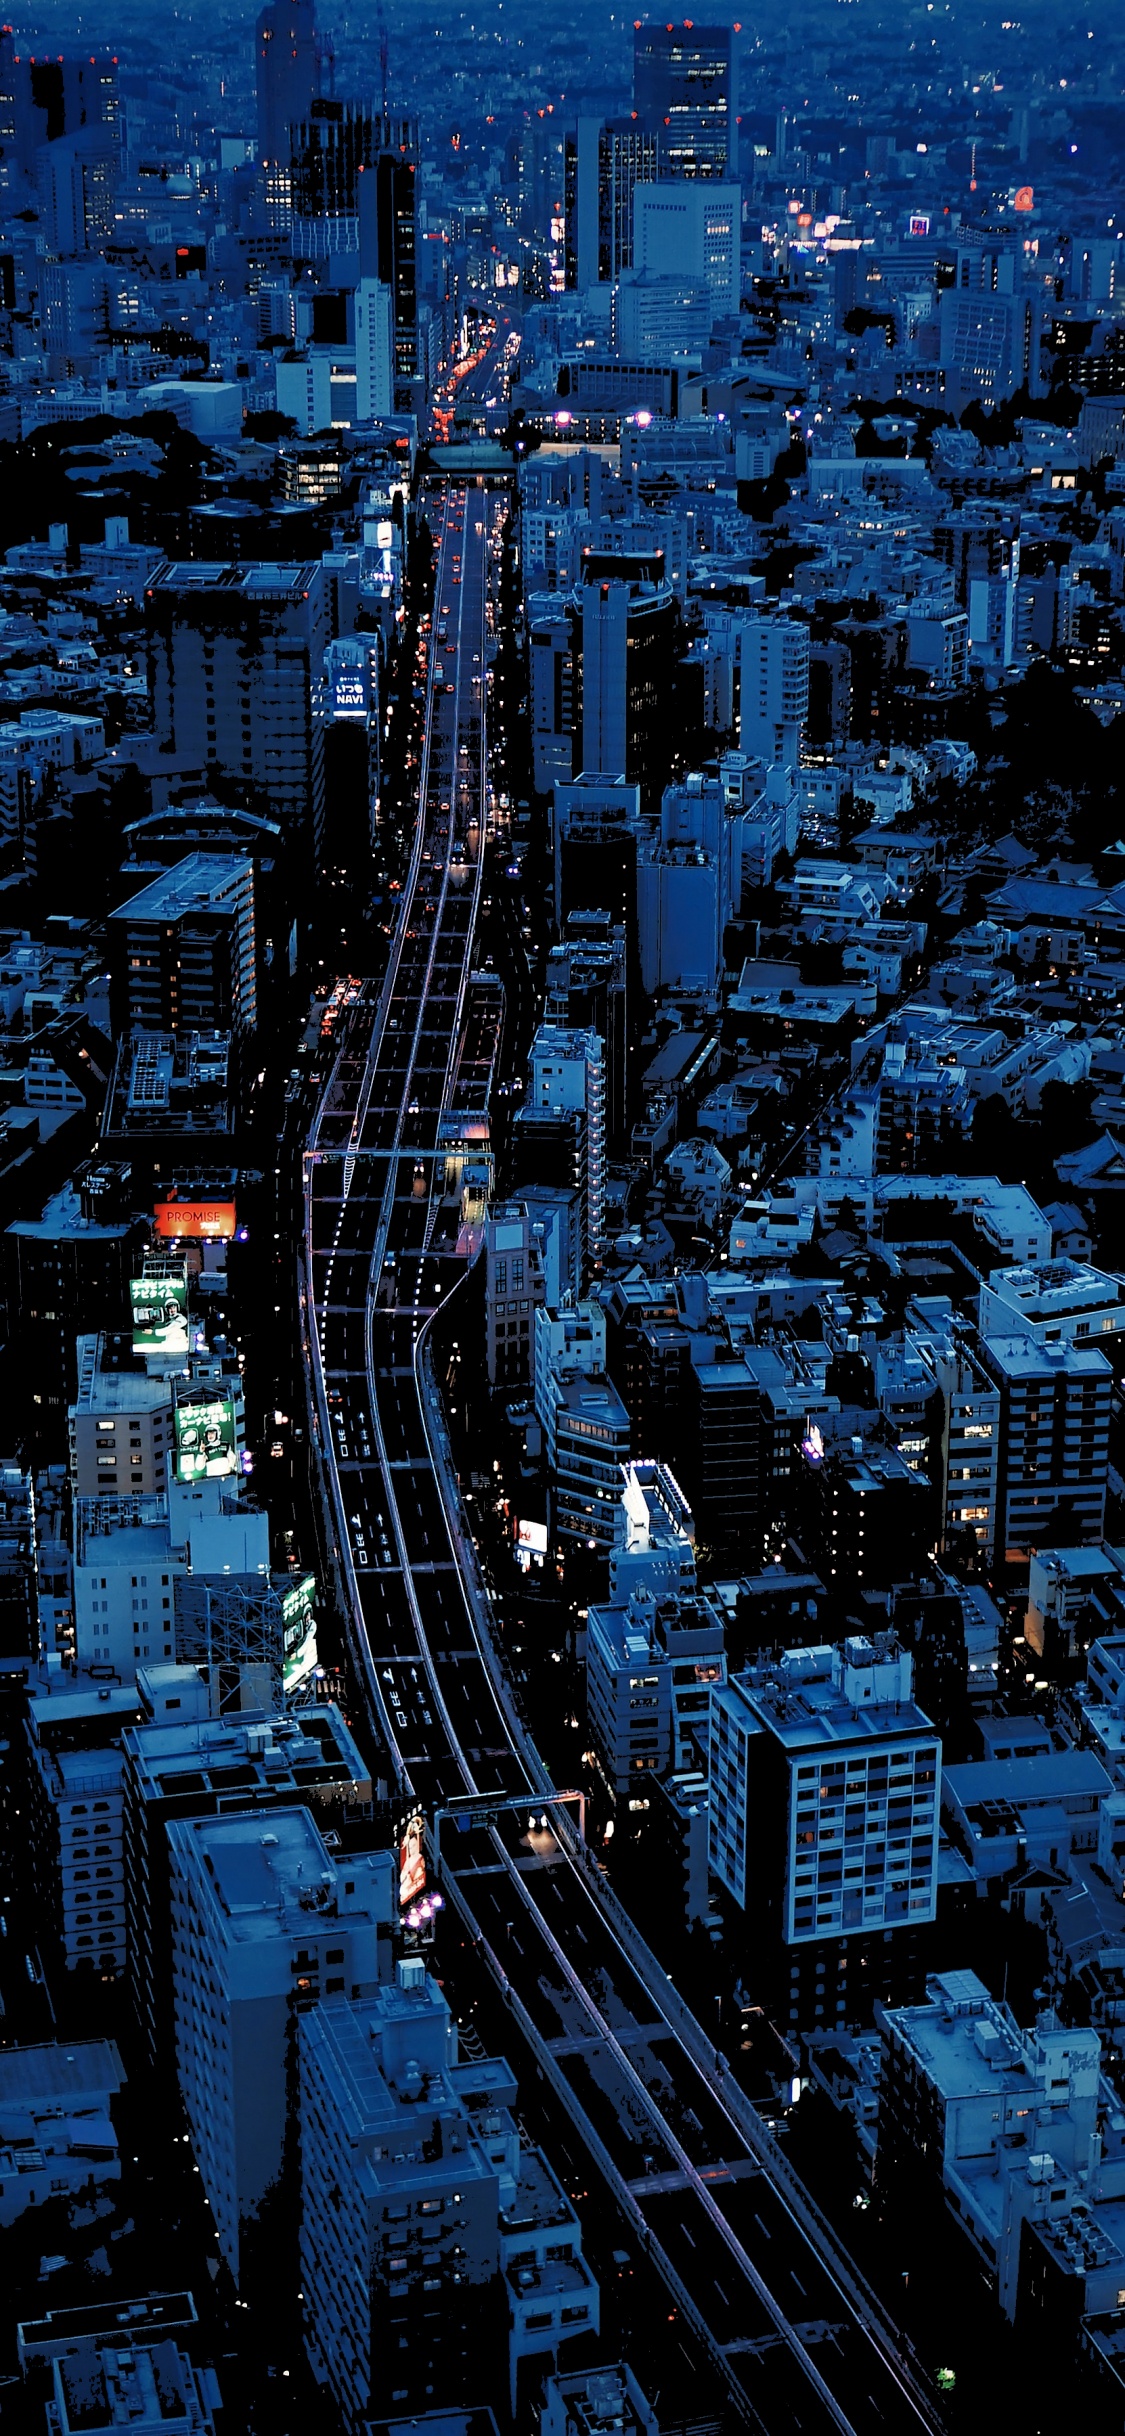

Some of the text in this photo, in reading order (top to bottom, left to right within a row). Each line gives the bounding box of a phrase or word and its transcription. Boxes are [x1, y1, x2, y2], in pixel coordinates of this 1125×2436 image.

[336, 684, 363, 694] いつも
[337, 695, 363, 704] NAVI
[167, 1211, 220, 1222] PROMISE
[132, 1289, 174, 1299] ナビタイム
